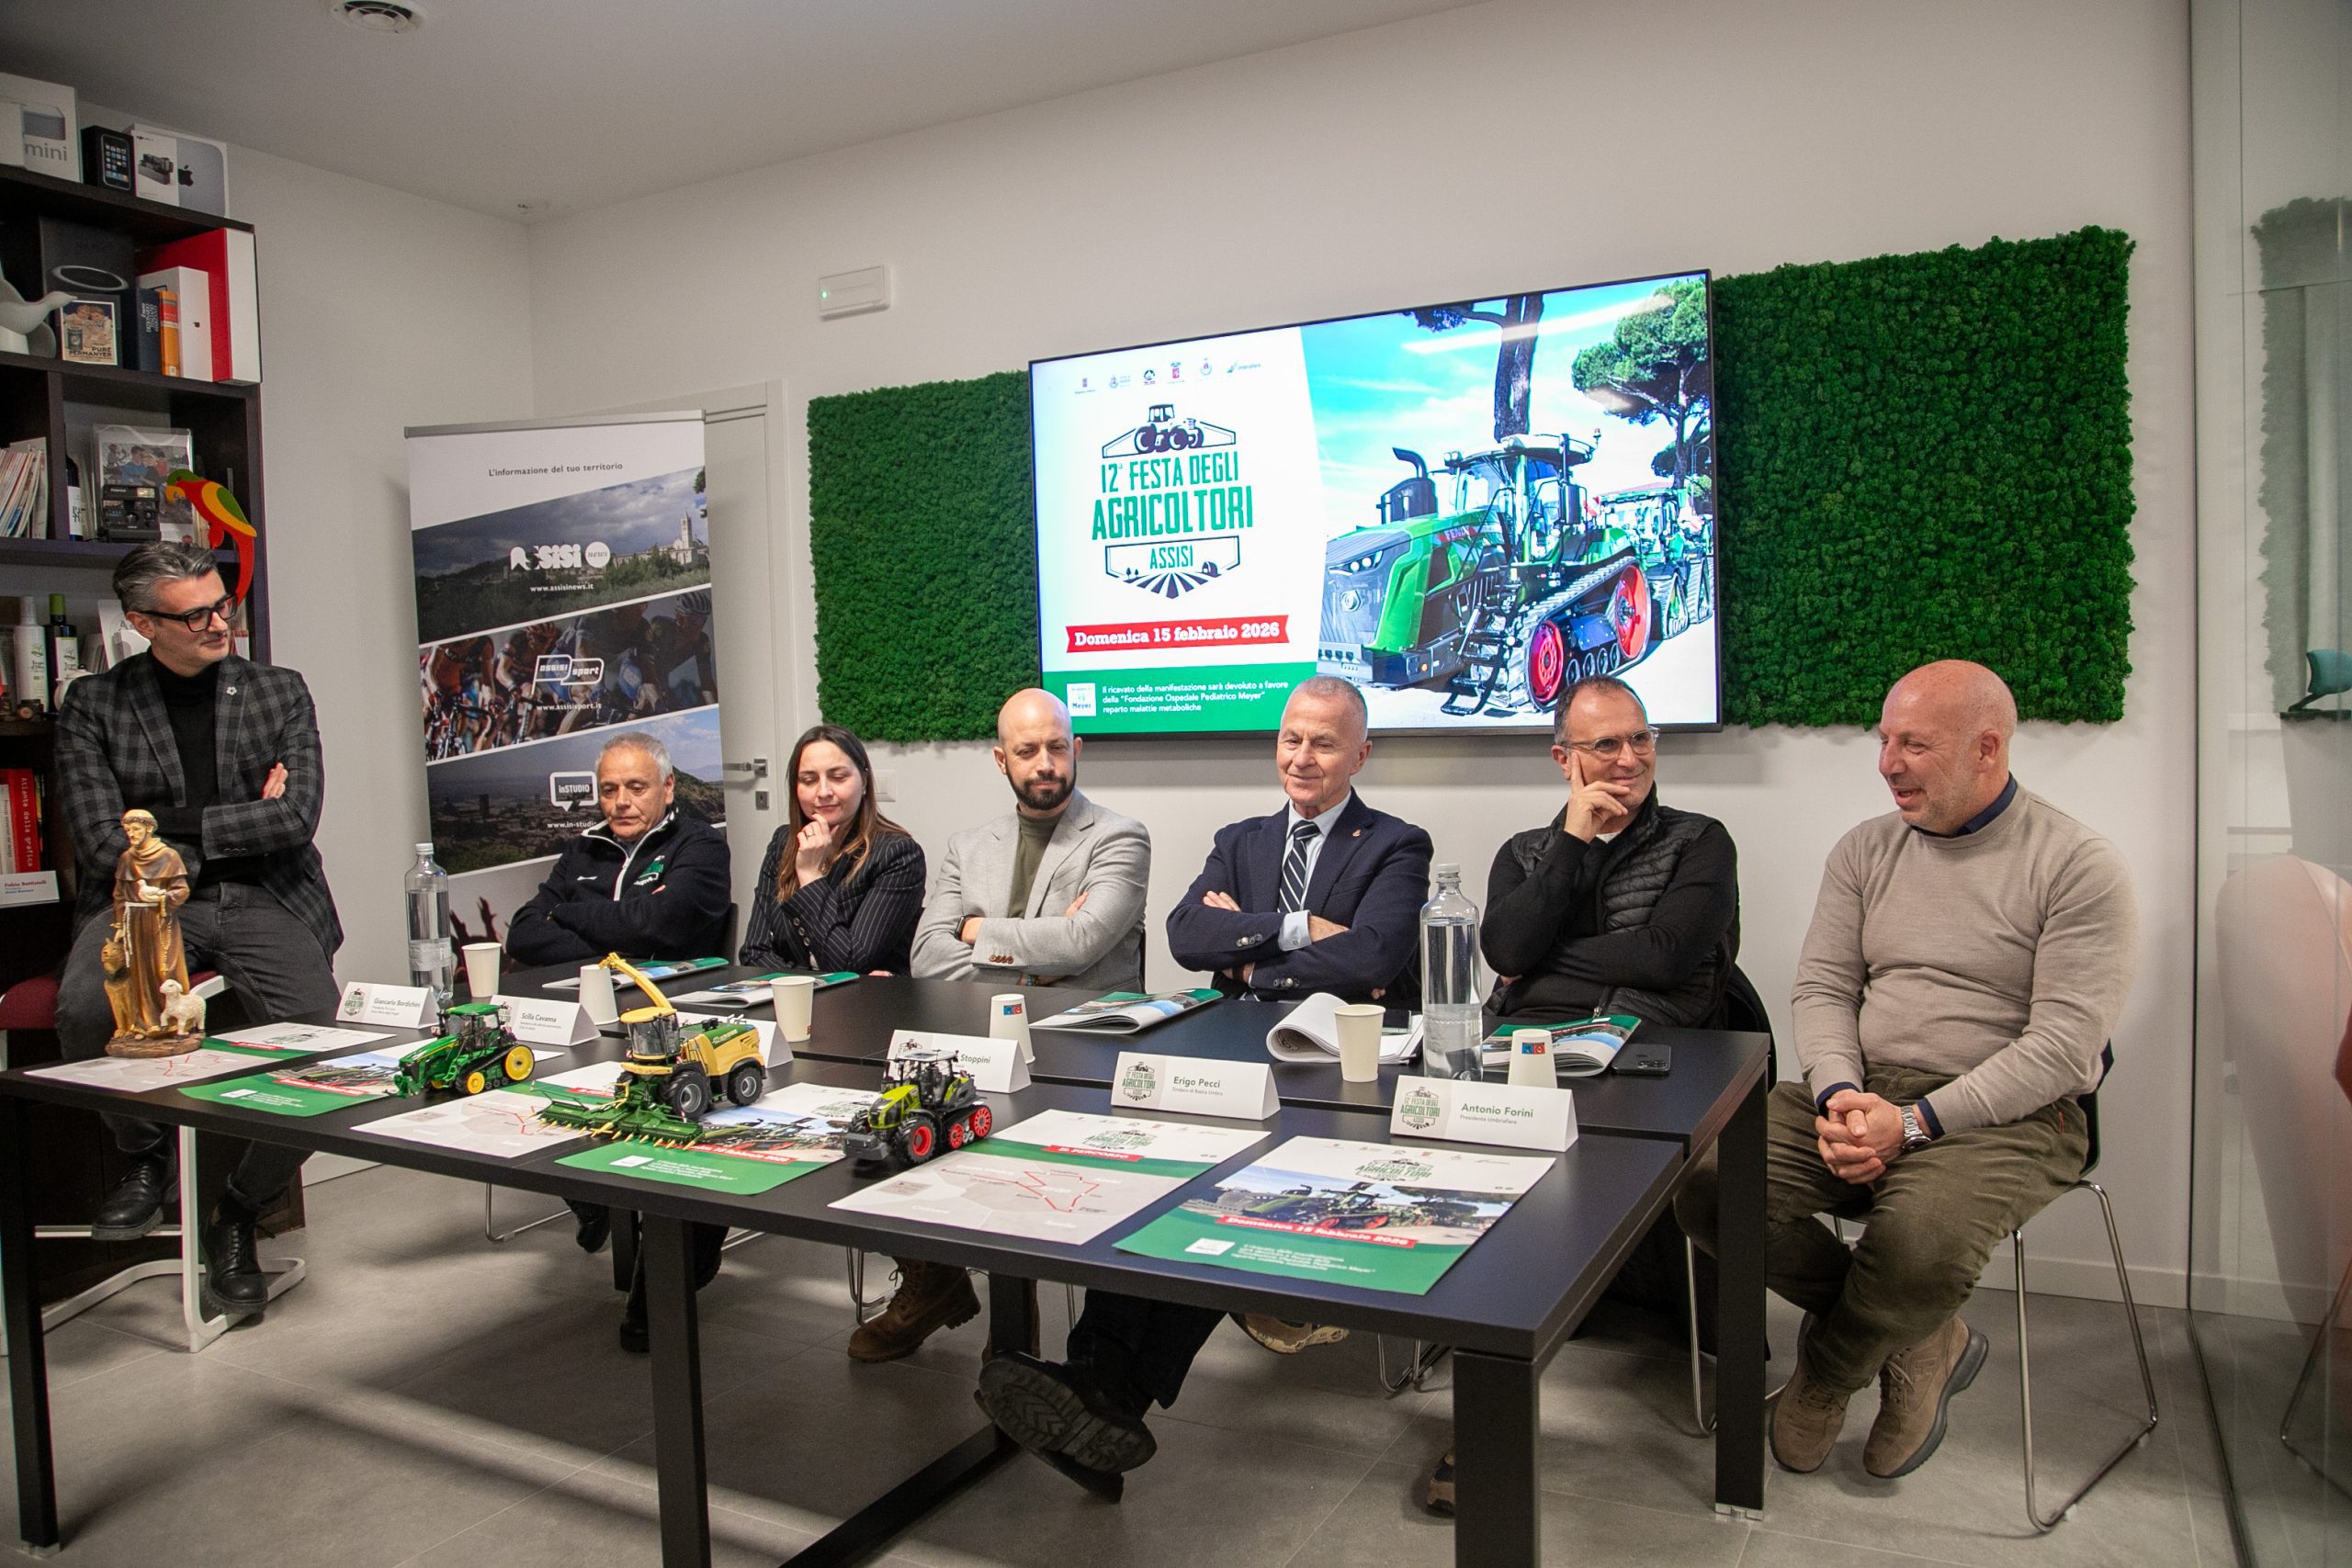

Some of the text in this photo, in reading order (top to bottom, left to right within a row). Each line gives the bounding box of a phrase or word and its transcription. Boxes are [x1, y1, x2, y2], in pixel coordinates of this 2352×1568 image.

[25, 142, 67, 162] mini
[488, 467, 548, 477] L'informazione
[551, 465, 564, 473] del
[582, 462, 623, 471] territorio
[1129, 457, 1183, 491] FESTA
[1189, 451, 1238, 485] DEGLI
[1091, 485, 1253, 540] AGRICOLTORI
[1149, 545, 1193, 570] ASSISI
[530, 583, 594, 592] www.assisinews.it
[1074, 622, 1280, 647] Domenica 15 febbraio 2026
[571, 667, 600, 677] sport
[1108, 685, 1135, 694] ricavato
[1136, 683, 1153, 693] della
[1154, 683, 1206, 692] manifestazione
[1225, 681, 1257, 690] devoluto
[1264, 680, 1288, 689] favore
[1102, 695, 1119, 704] della
[1165, 693, 1199, 704] Ospedale
[1200, 692, 1237, 701] Pediatrico
[537, 702, 602, 711] www.assisisport.it
[1102, 703, 1202, 715] reparto malattie metaboliche
[558, 784, 590, 794] inSTUDIO
[24, 837, 34, 867] grafica
[374, 998, 396, 1006] Giancarlo
[536, 1014, 557, 1022] Cavanna
[960, 1054, 991, 1064] Stoppini
[1122, 1078, 1156, 1089] AGRICOLTORI
[1173, 1076, 1221, 1089] Erigo Pecci
[1411, 1097, 1425, 1105] FESTA
[1399, 1104, 1441, 1118] AGRICOLTORI
[1461, 1103, 1533, 1118] Antonio Forini
[1071, 1148, 1129, 1159] PERCORSO
[1226, 1216, 1294, 1231] Domenica
[1313, 1226, 1371, 1240] febbraio
[1373, 1235, 1409, 1246] 2026
